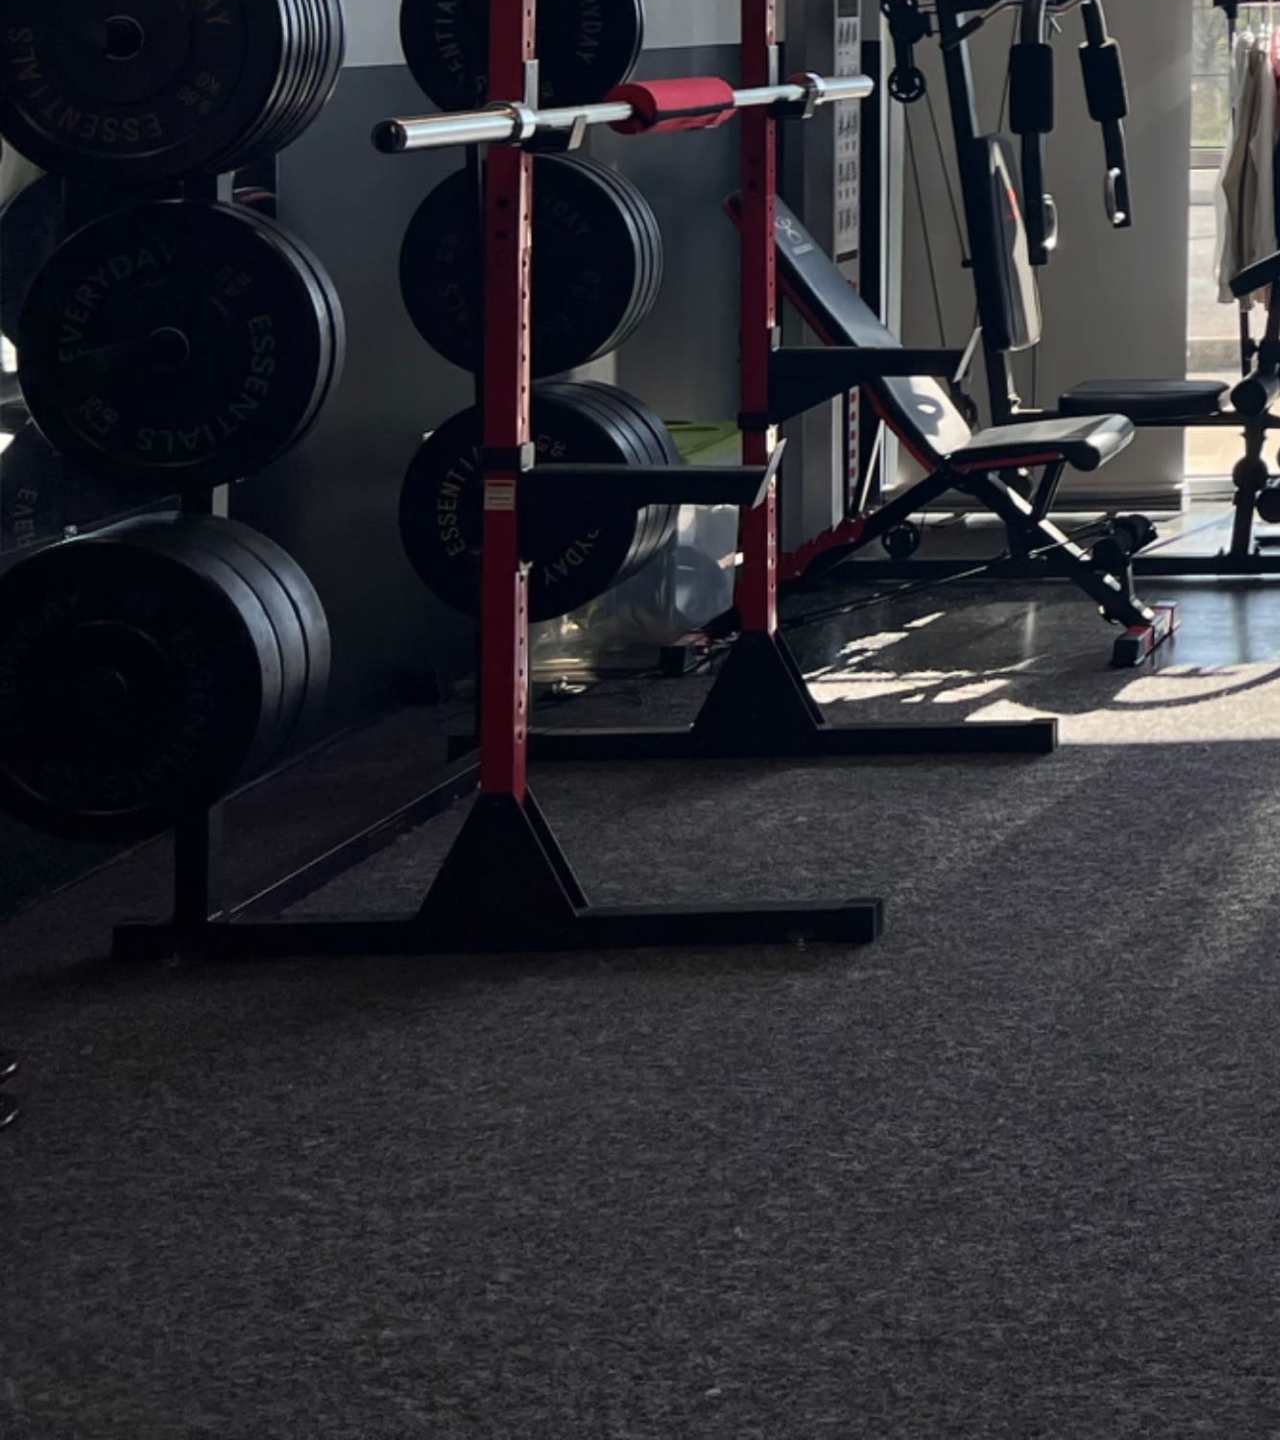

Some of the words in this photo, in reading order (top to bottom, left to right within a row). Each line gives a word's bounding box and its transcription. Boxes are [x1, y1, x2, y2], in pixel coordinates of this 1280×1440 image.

[7, 25, 164, 144] ESSENTIALS
[58, 238, 177, 364] EVERYDAY
[135, 313, 277, 455] ESSENTIALS
[436, 446, 482, 560] ESSENTI
